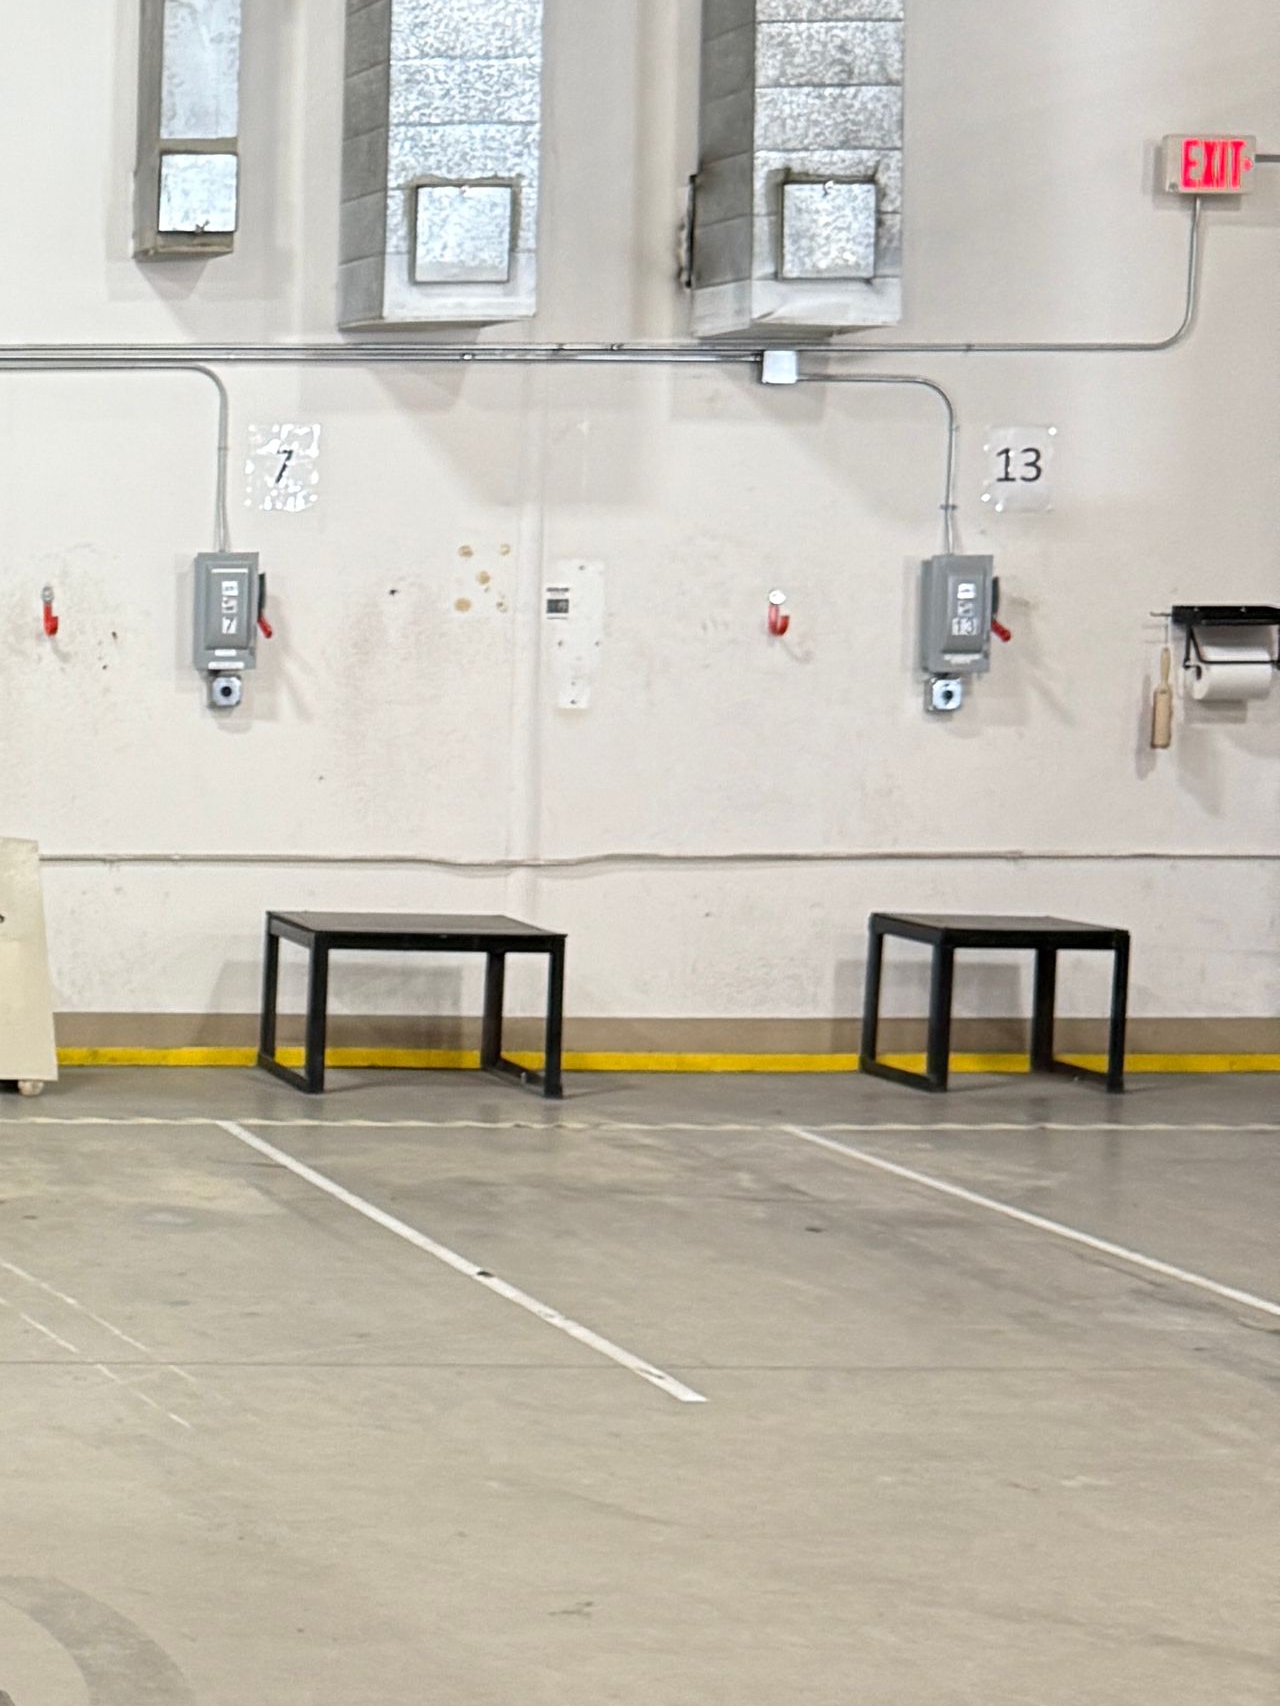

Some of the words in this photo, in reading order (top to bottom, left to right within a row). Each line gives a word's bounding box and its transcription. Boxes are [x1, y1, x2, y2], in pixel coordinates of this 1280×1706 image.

[1182, 138, 1246, 191] EXIT
[275, 449, 294, 484] 7
[995, 447, 1042, 482] 13
